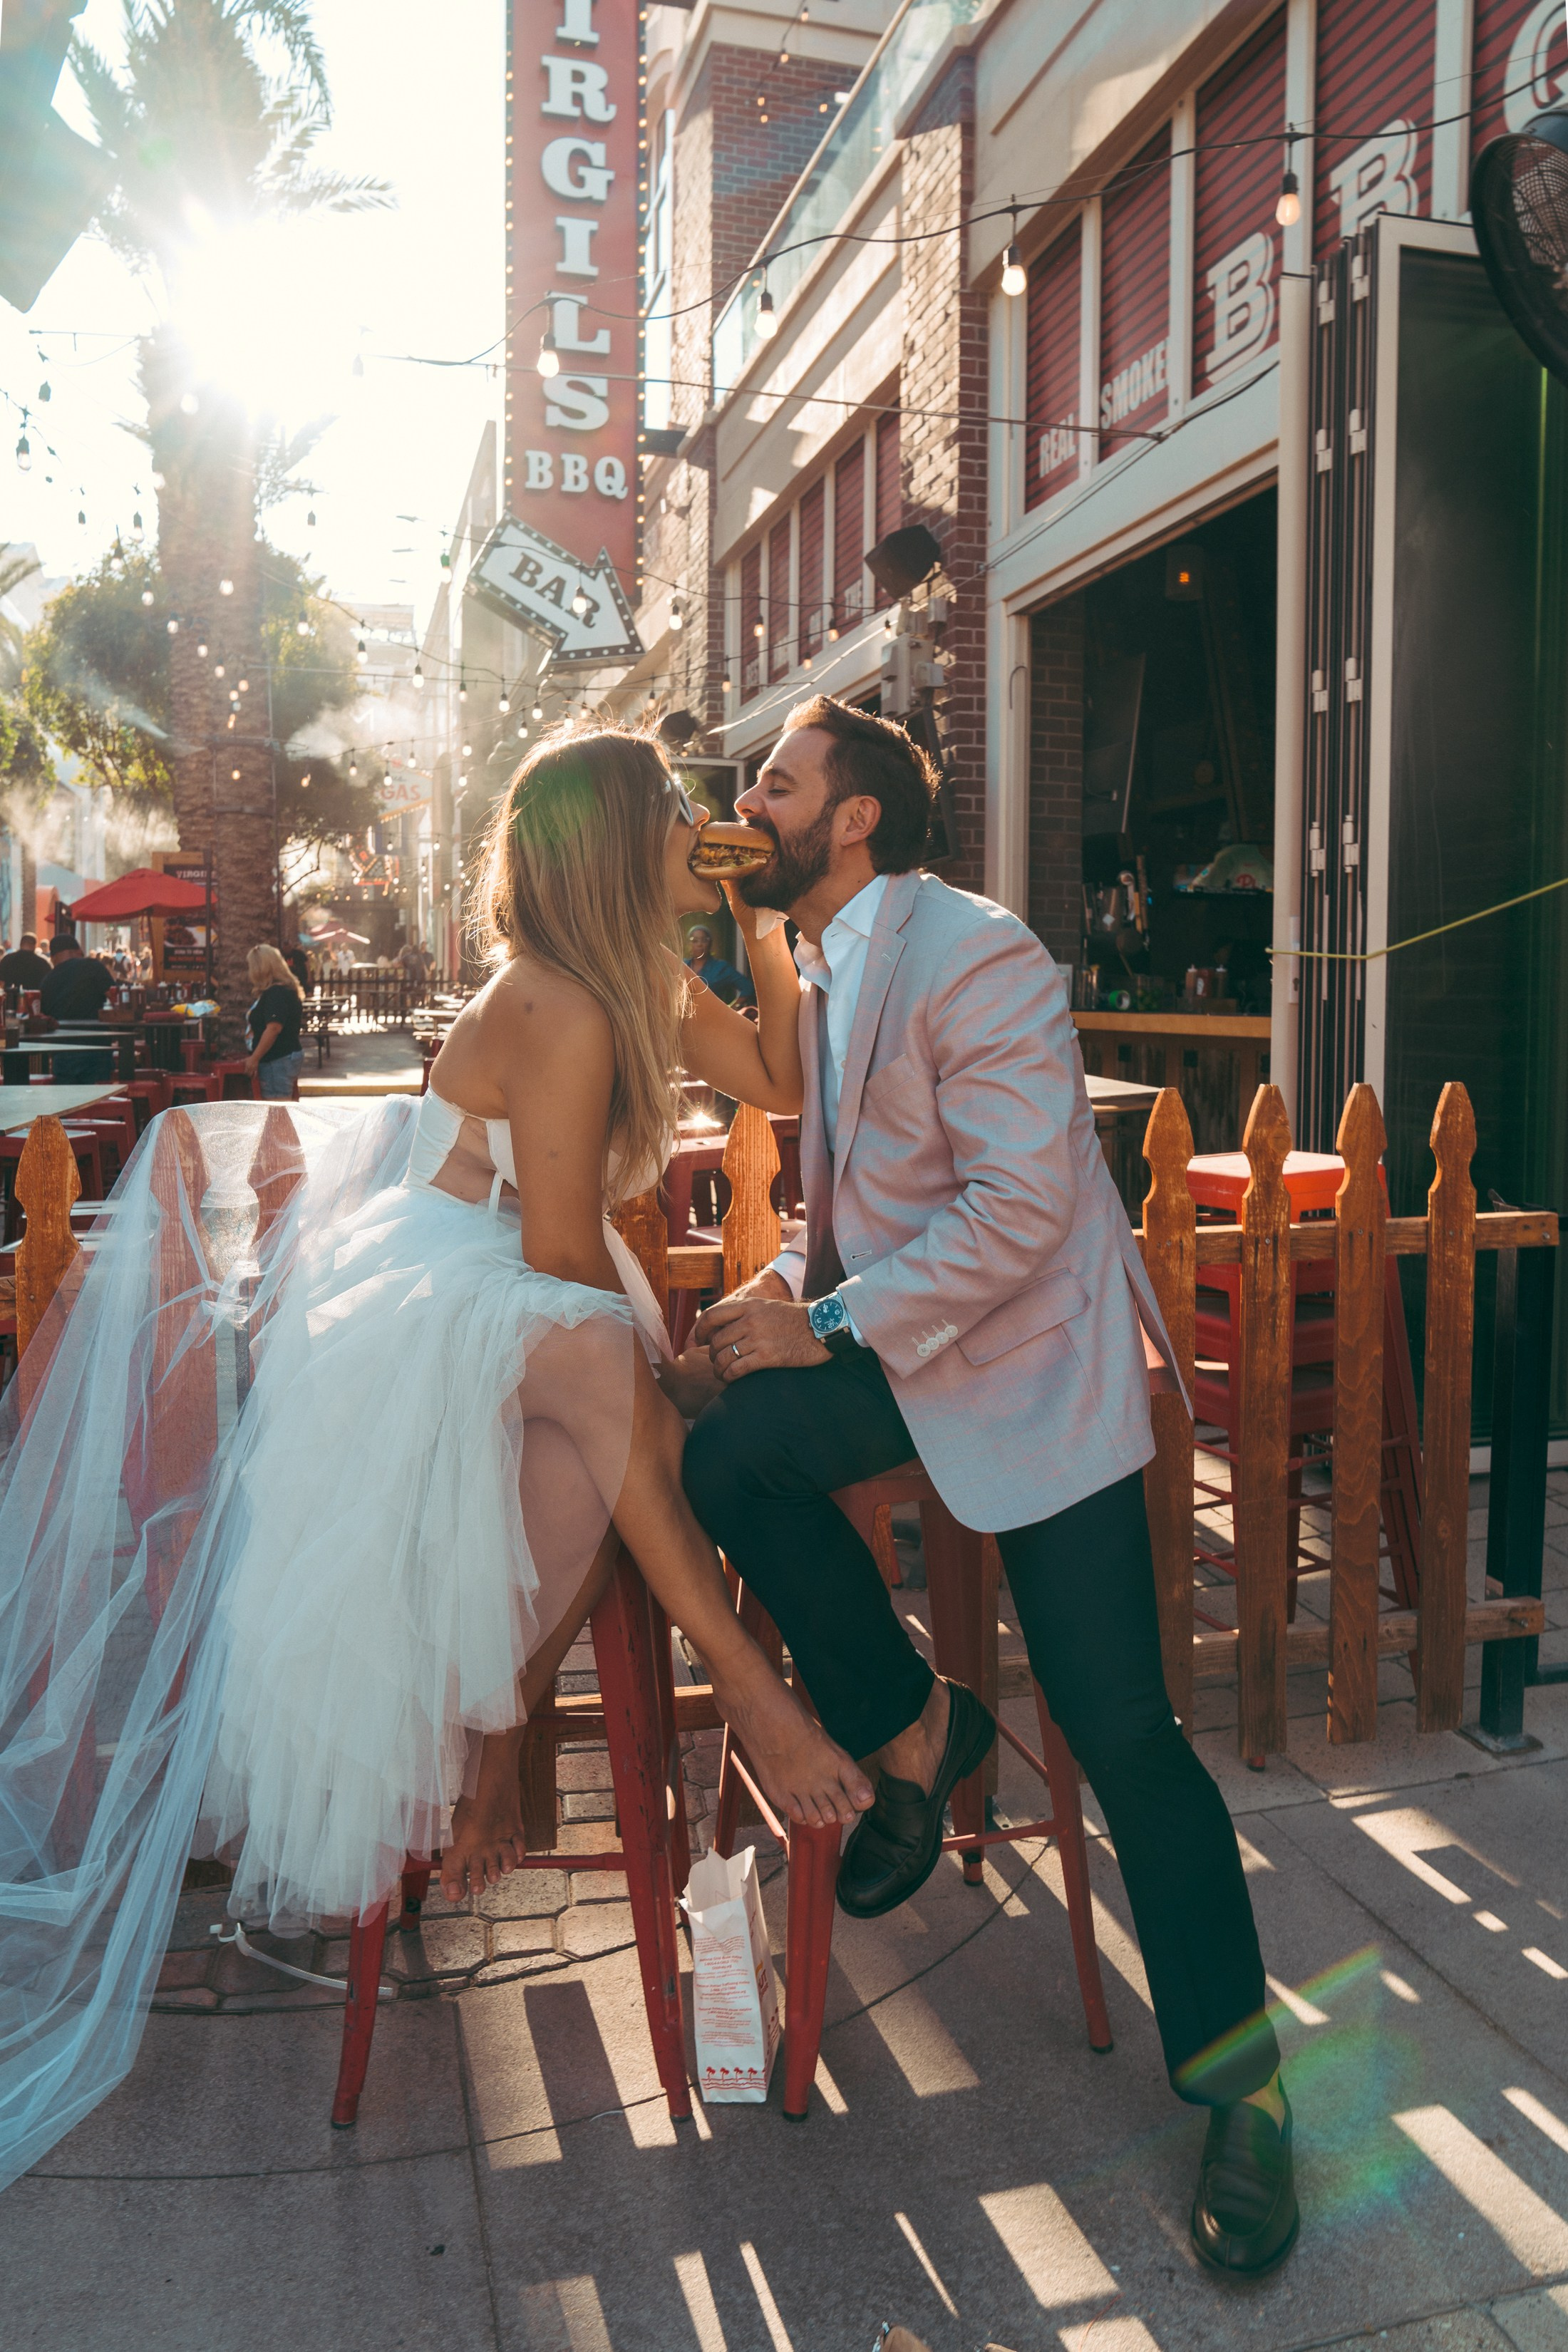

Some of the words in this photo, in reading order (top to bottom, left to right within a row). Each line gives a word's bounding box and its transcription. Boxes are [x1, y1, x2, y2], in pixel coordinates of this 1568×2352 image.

[1040, 412, 1076, 479] REAL
[1101, 336, 1169, 430] SMOKE
[525, 450, 628, 500] BBQ
[509, 552, 600, 629] BAR
[380, 784, 421, 801] GAS
